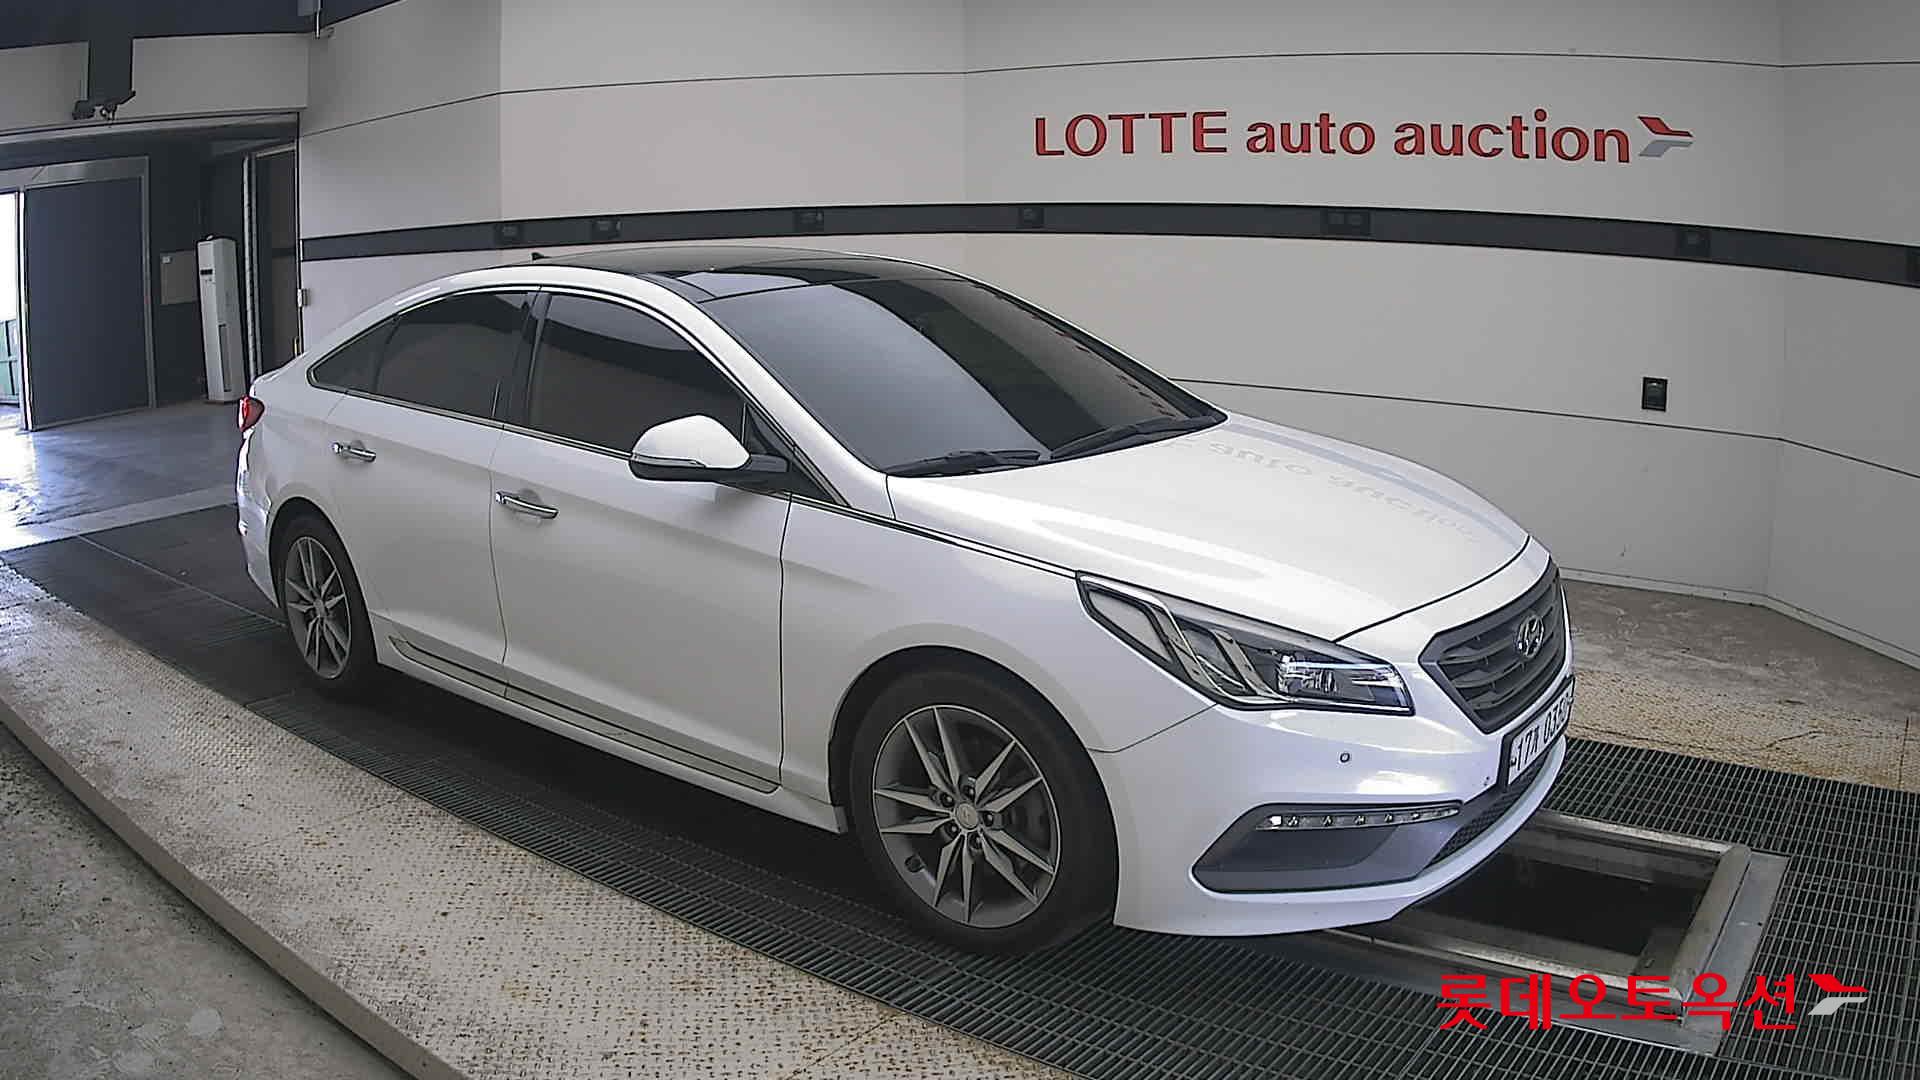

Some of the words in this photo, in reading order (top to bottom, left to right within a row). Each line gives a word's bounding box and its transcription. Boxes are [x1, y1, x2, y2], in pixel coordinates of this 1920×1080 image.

[1035, 112, 1229, 157] LOTTE
[1246, 113, 1375, 155] auto
[1394, 110, 1631, 162] auction
